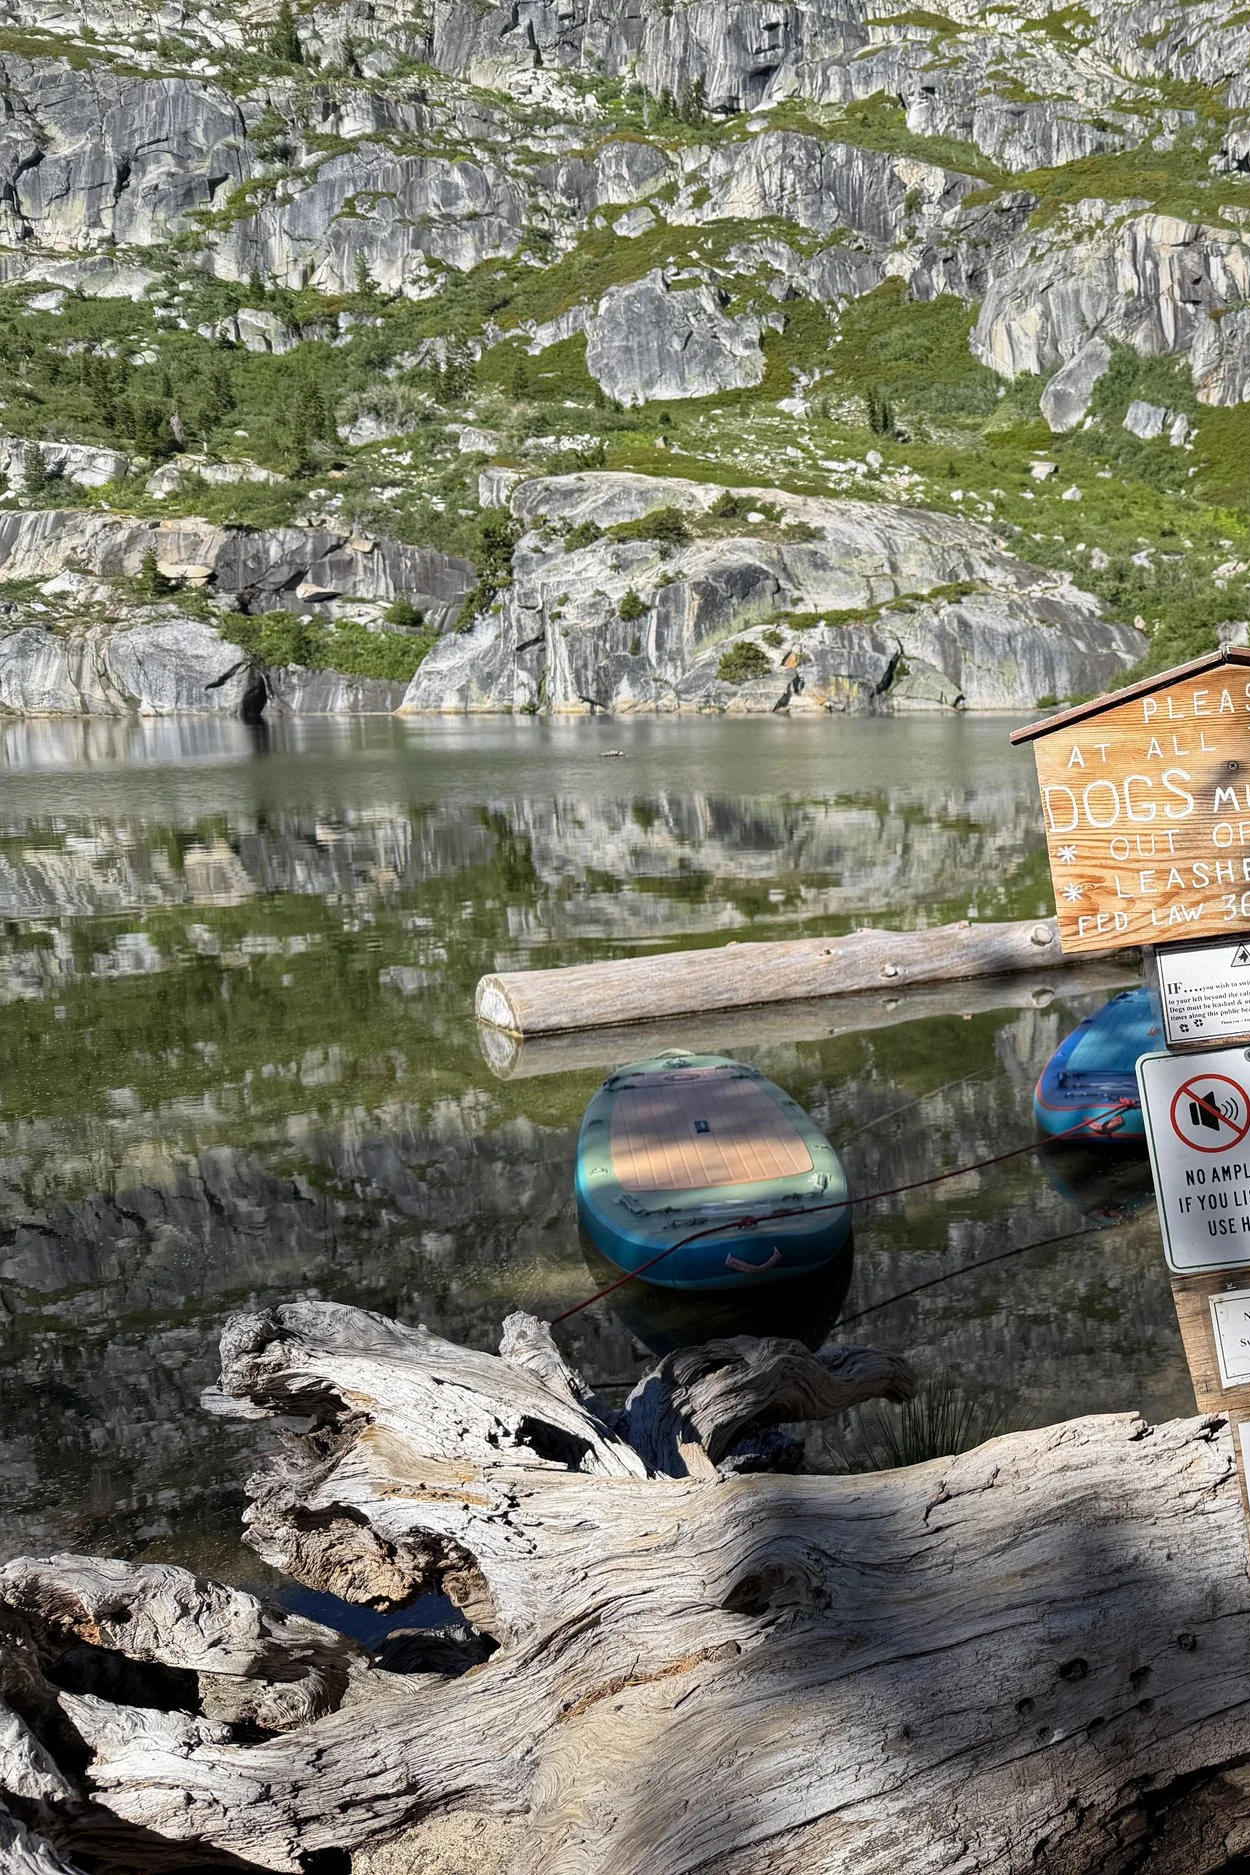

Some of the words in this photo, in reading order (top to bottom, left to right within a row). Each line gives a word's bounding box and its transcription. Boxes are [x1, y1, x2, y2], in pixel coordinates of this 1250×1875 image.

[1067, 743, 1111, 768] AT
[1147, 732, 1216, 760] ALL
[1042, 768, 1195, 833] DOGS
[1109, 829, 1180, 861] OUT
[1079, 911, 1128, 936] FED
[1152, 902, 1203, 926] LAW
[1204, 993, 1227, 1001] beyond
[1212, 1000, 1236, 1008] leashed
[1220, 1008, 1240, 1016] public
[1185, 1168, 1206, 1186] NO
[1178, 1197, 1193, 1214] IF
[1196, 1192, 1228, 1211] YOU
[1208, 1218, 1237, 1236] USE
